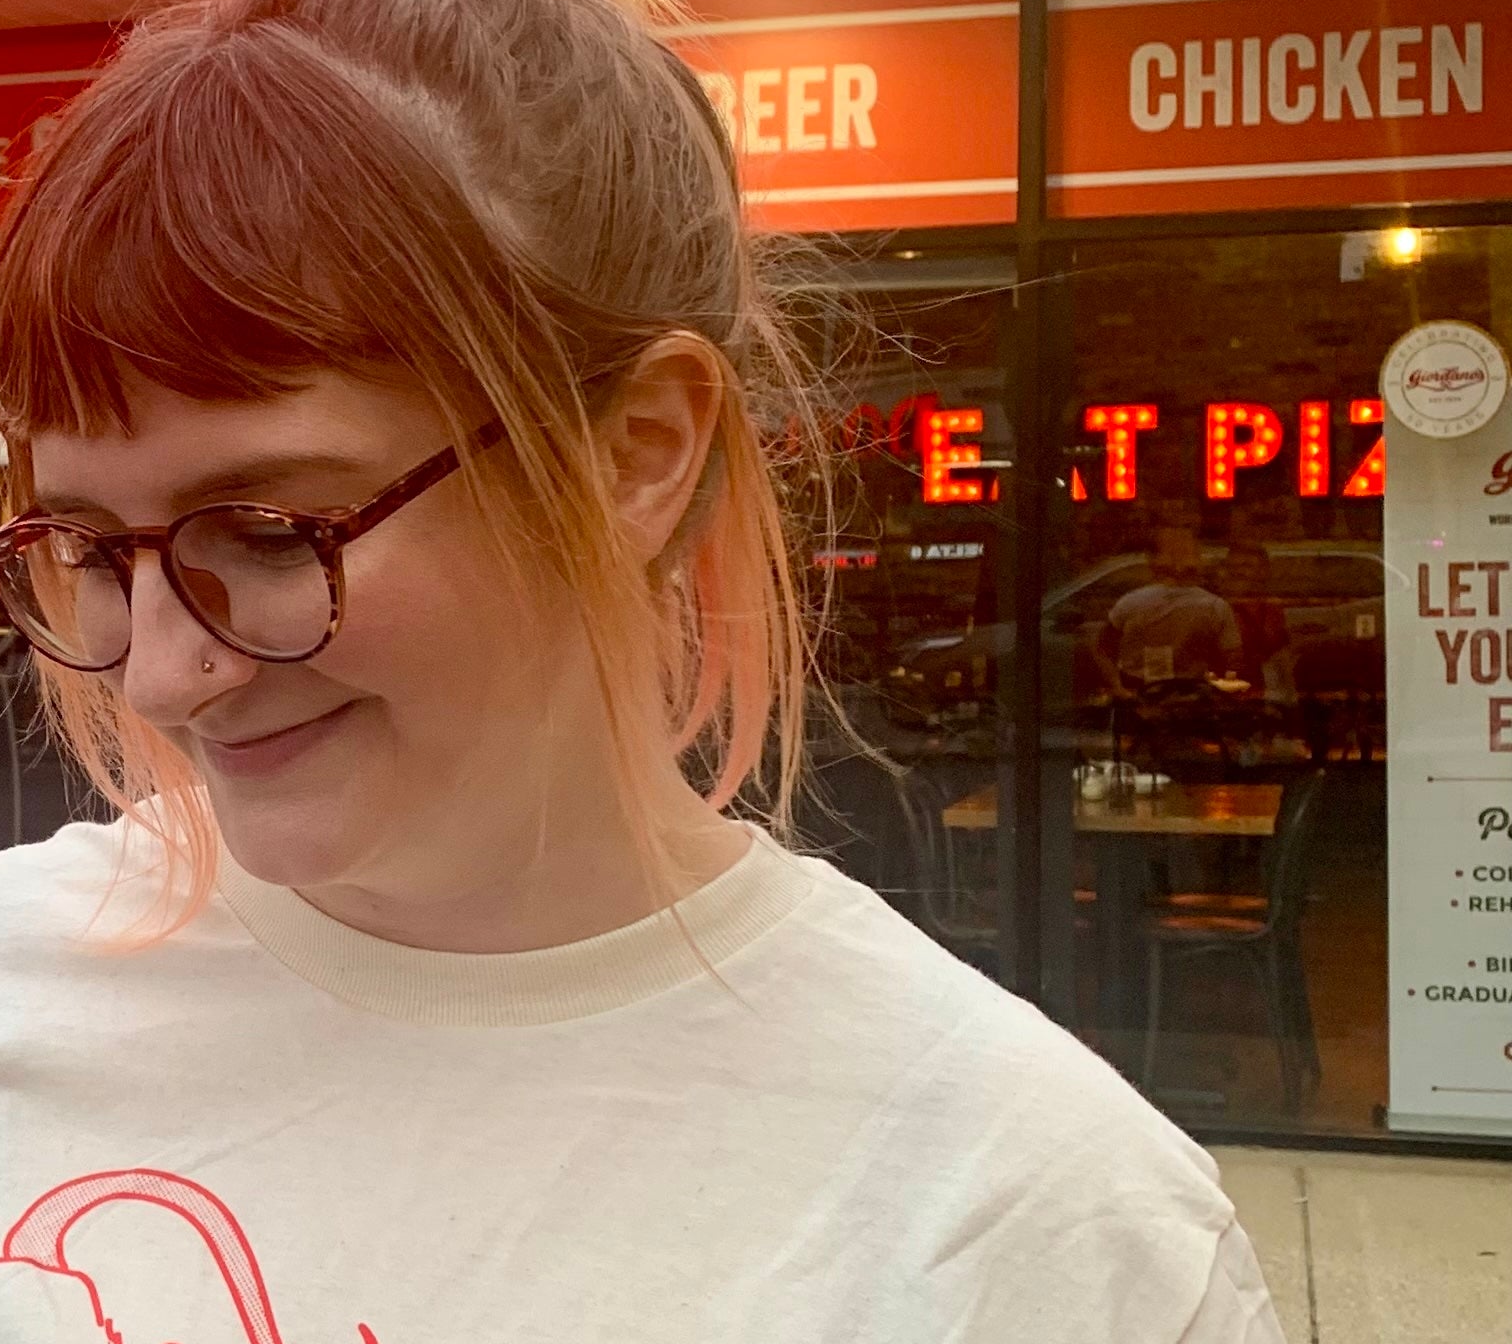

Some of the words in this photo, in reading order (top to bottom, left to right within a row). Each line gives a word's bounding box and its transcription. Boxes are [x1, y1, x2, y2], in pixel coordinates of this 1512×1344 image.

[1129, 22, 1483, 132] CHICKEN
[924, 405, 1158, 503] ET
[1435, 628, 1512, 685] YO
[1472, 865, 1512, 882] CO
[1425, 986, 1512, 1003] GRADU
